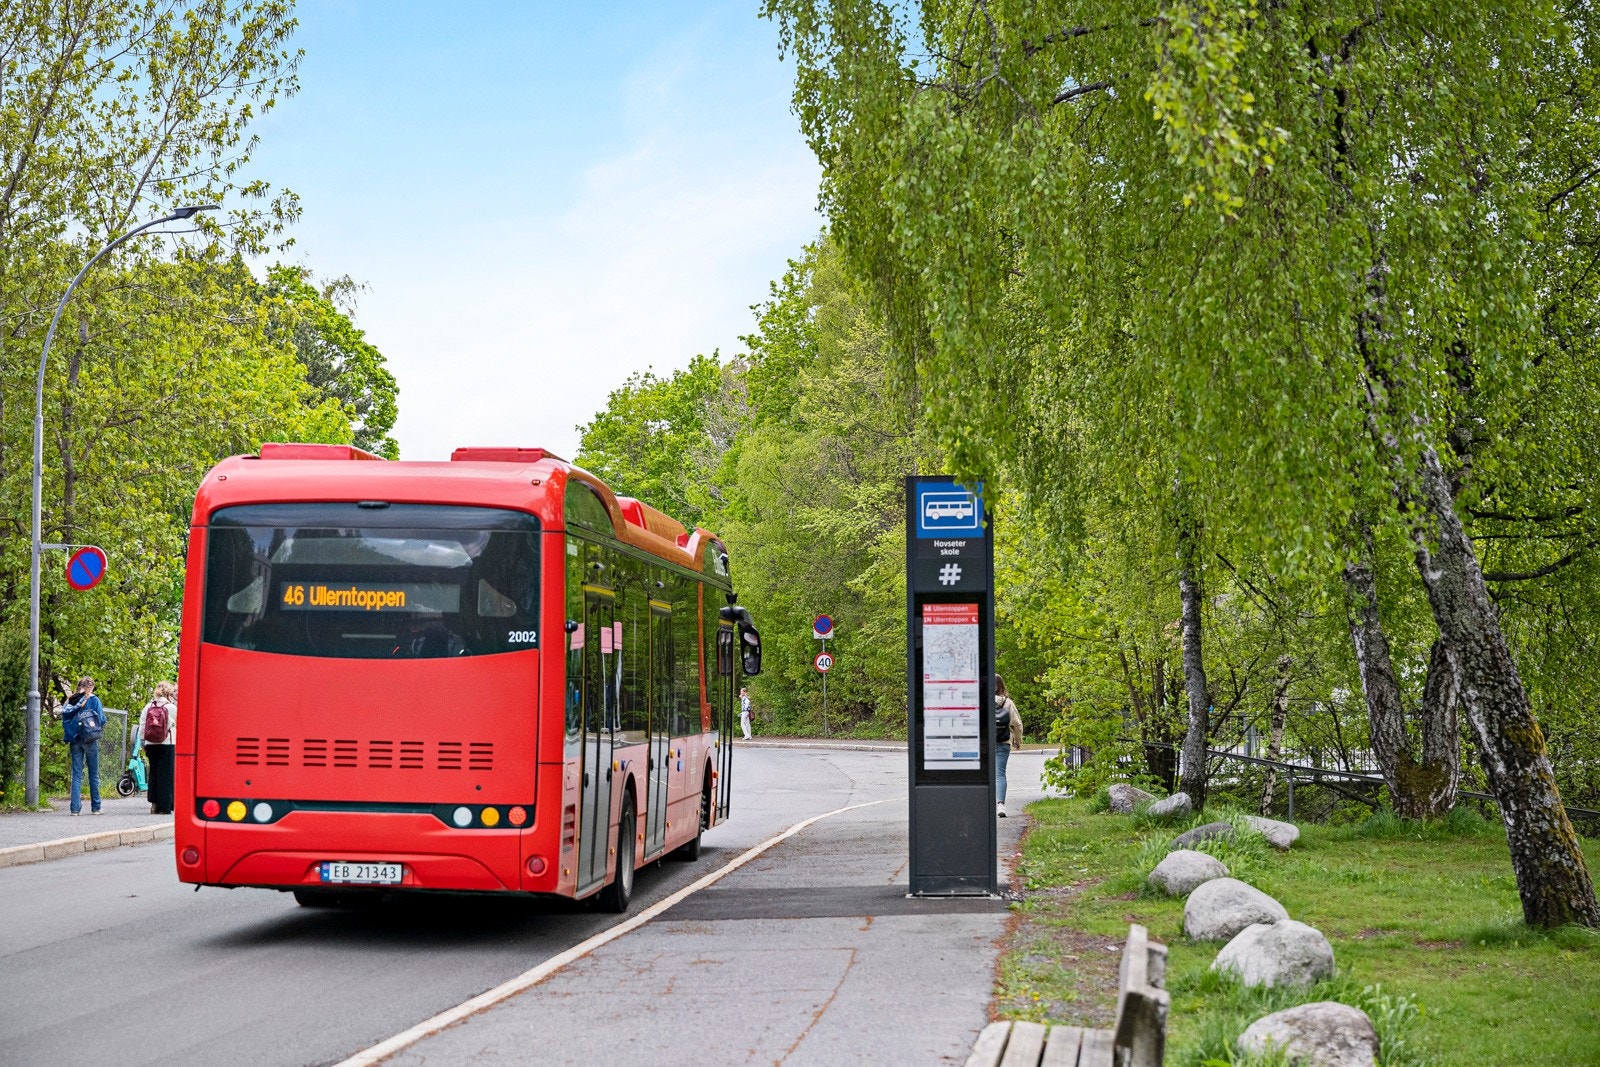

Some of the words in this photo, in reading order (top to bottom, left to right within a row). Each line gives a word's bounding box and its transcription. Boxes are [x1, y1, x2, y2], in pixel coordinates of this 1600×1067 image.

[933, 540, 966, 548] Hovseter
[940, 548, 960, 556] skole
[284, 585, 304, 605] 46
[309, 586, 405, 611] Ullerntoppen
[508, 631, 537, 643] 2002
[818, 657, 831, 668] 40
[334, 865, 350, 878] EB
[356, 866, 396, 879] 21343
